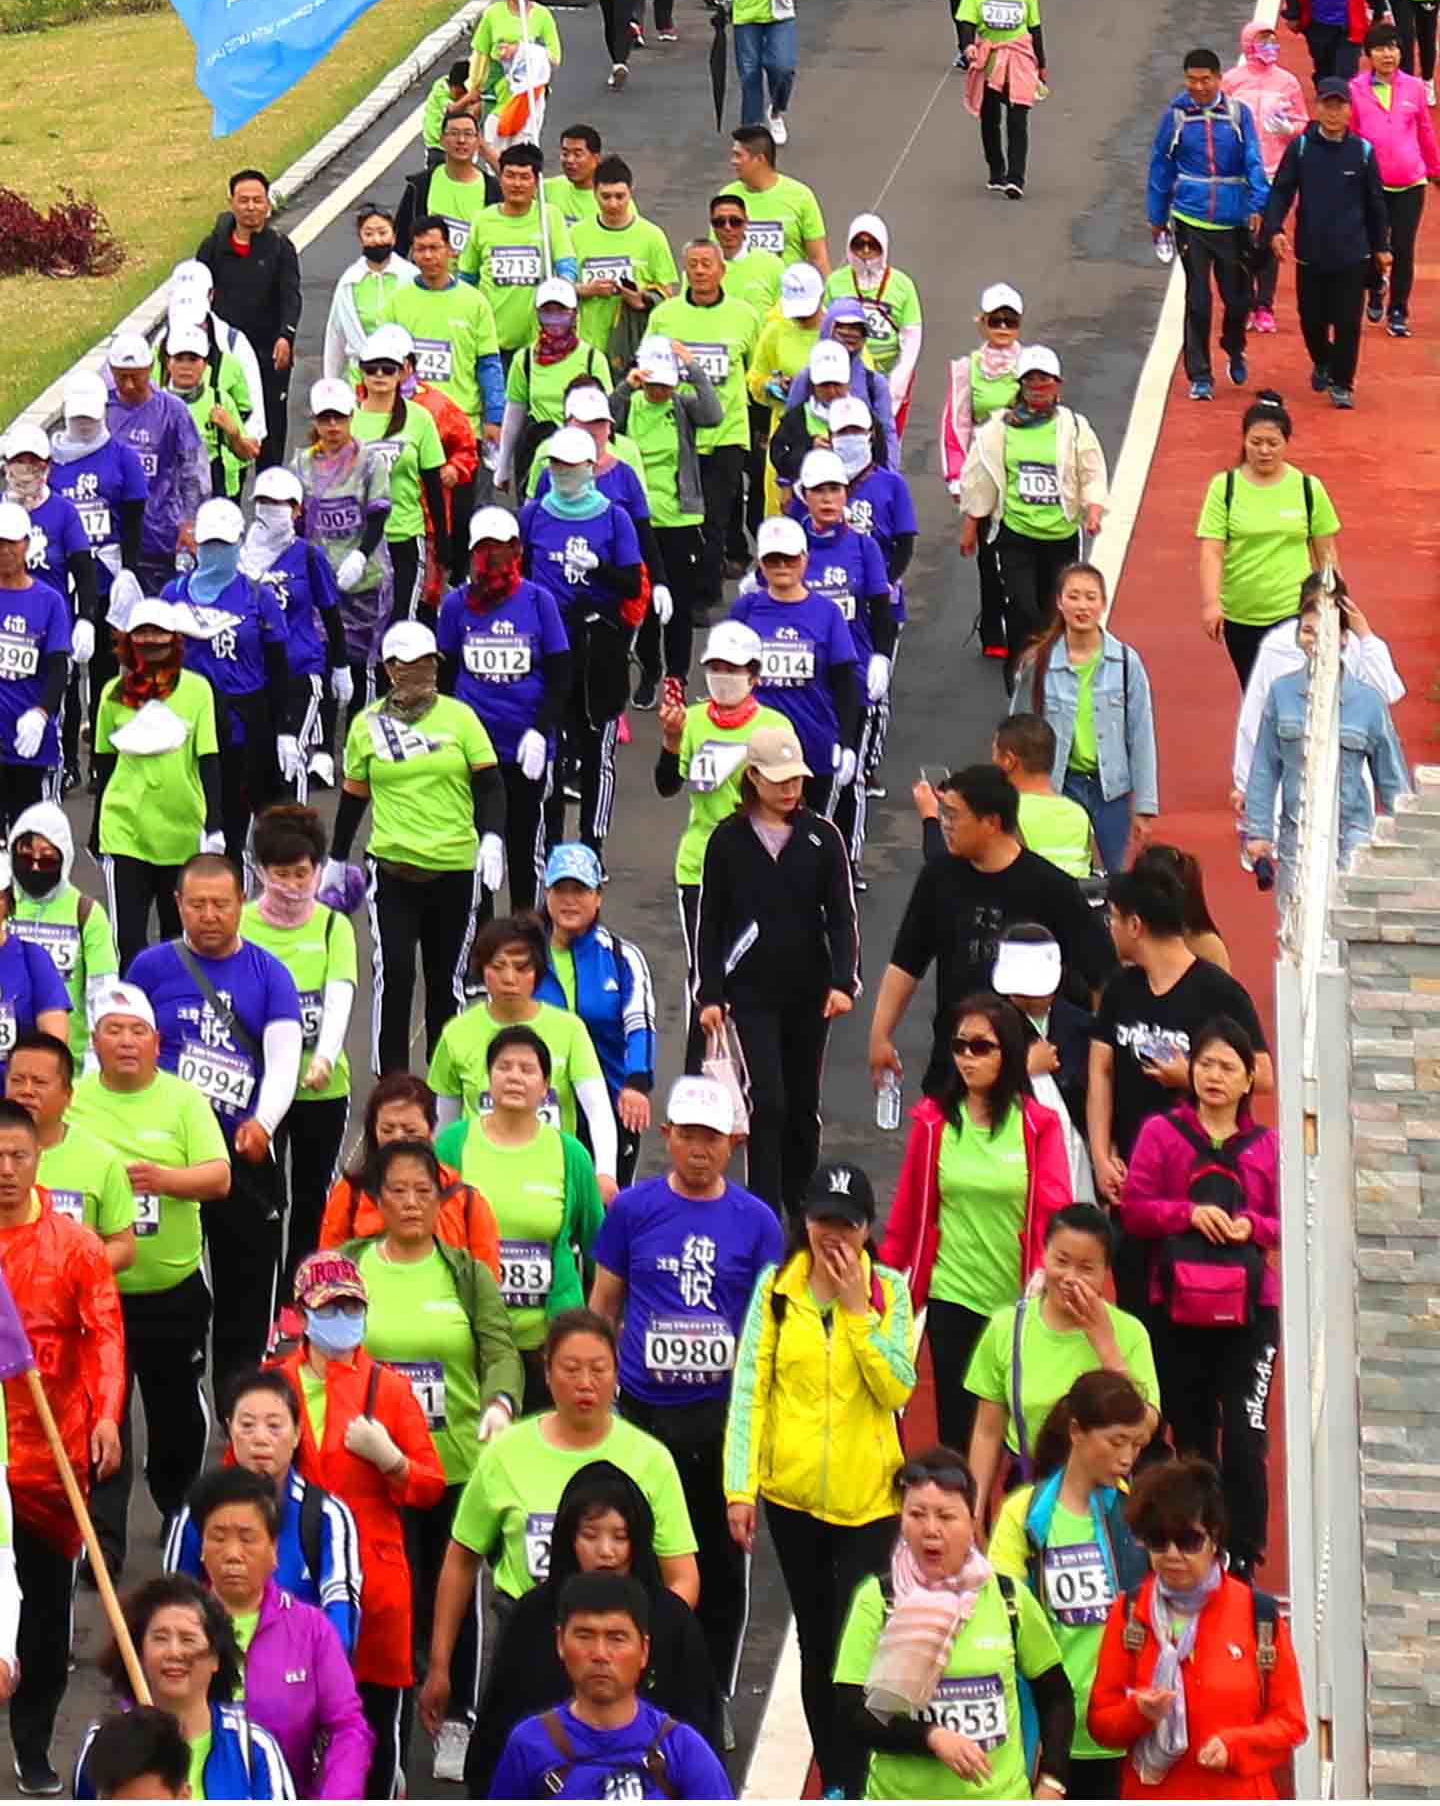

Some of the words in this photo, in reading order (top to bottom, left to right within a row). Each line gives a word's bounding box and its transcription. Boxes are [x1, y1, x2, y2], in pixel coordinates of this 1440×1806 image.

[496, 260, 536, 275] 2713
[471, 651, 525, 669] 1012
[181, 1059, 245, 1101] 0994
[680, 1234, 717, 1311] 纯悦
[651, 1337, 727, 1368] 0980
